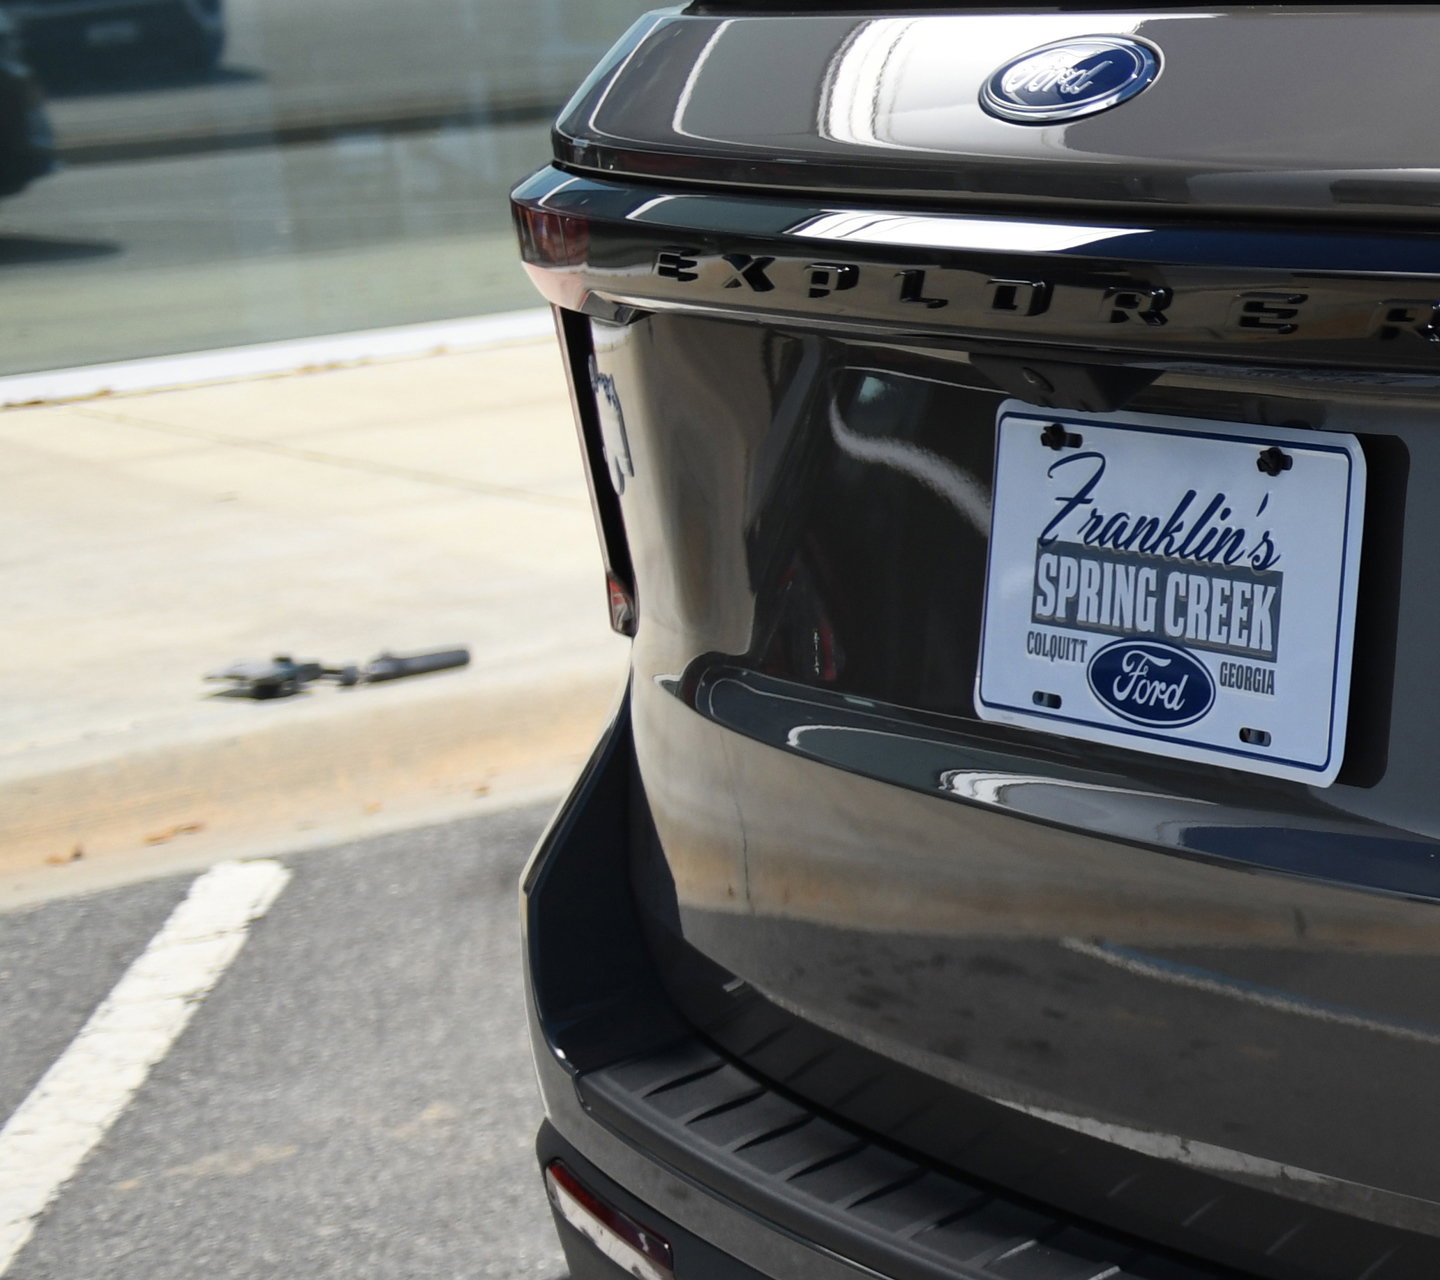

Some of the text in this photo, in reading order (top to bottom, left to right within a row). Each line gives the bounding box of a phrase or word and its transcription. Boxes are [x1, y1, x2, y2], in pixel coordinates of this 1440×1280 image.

[1037, 451, 1281, 572] Franklin's
[1034, 551, 1279, 653] SPRING CREEK
[1026, 629, 1276, 697] COLQUITT GEORGIA
[1111, 649, 1190, 712] Ford
